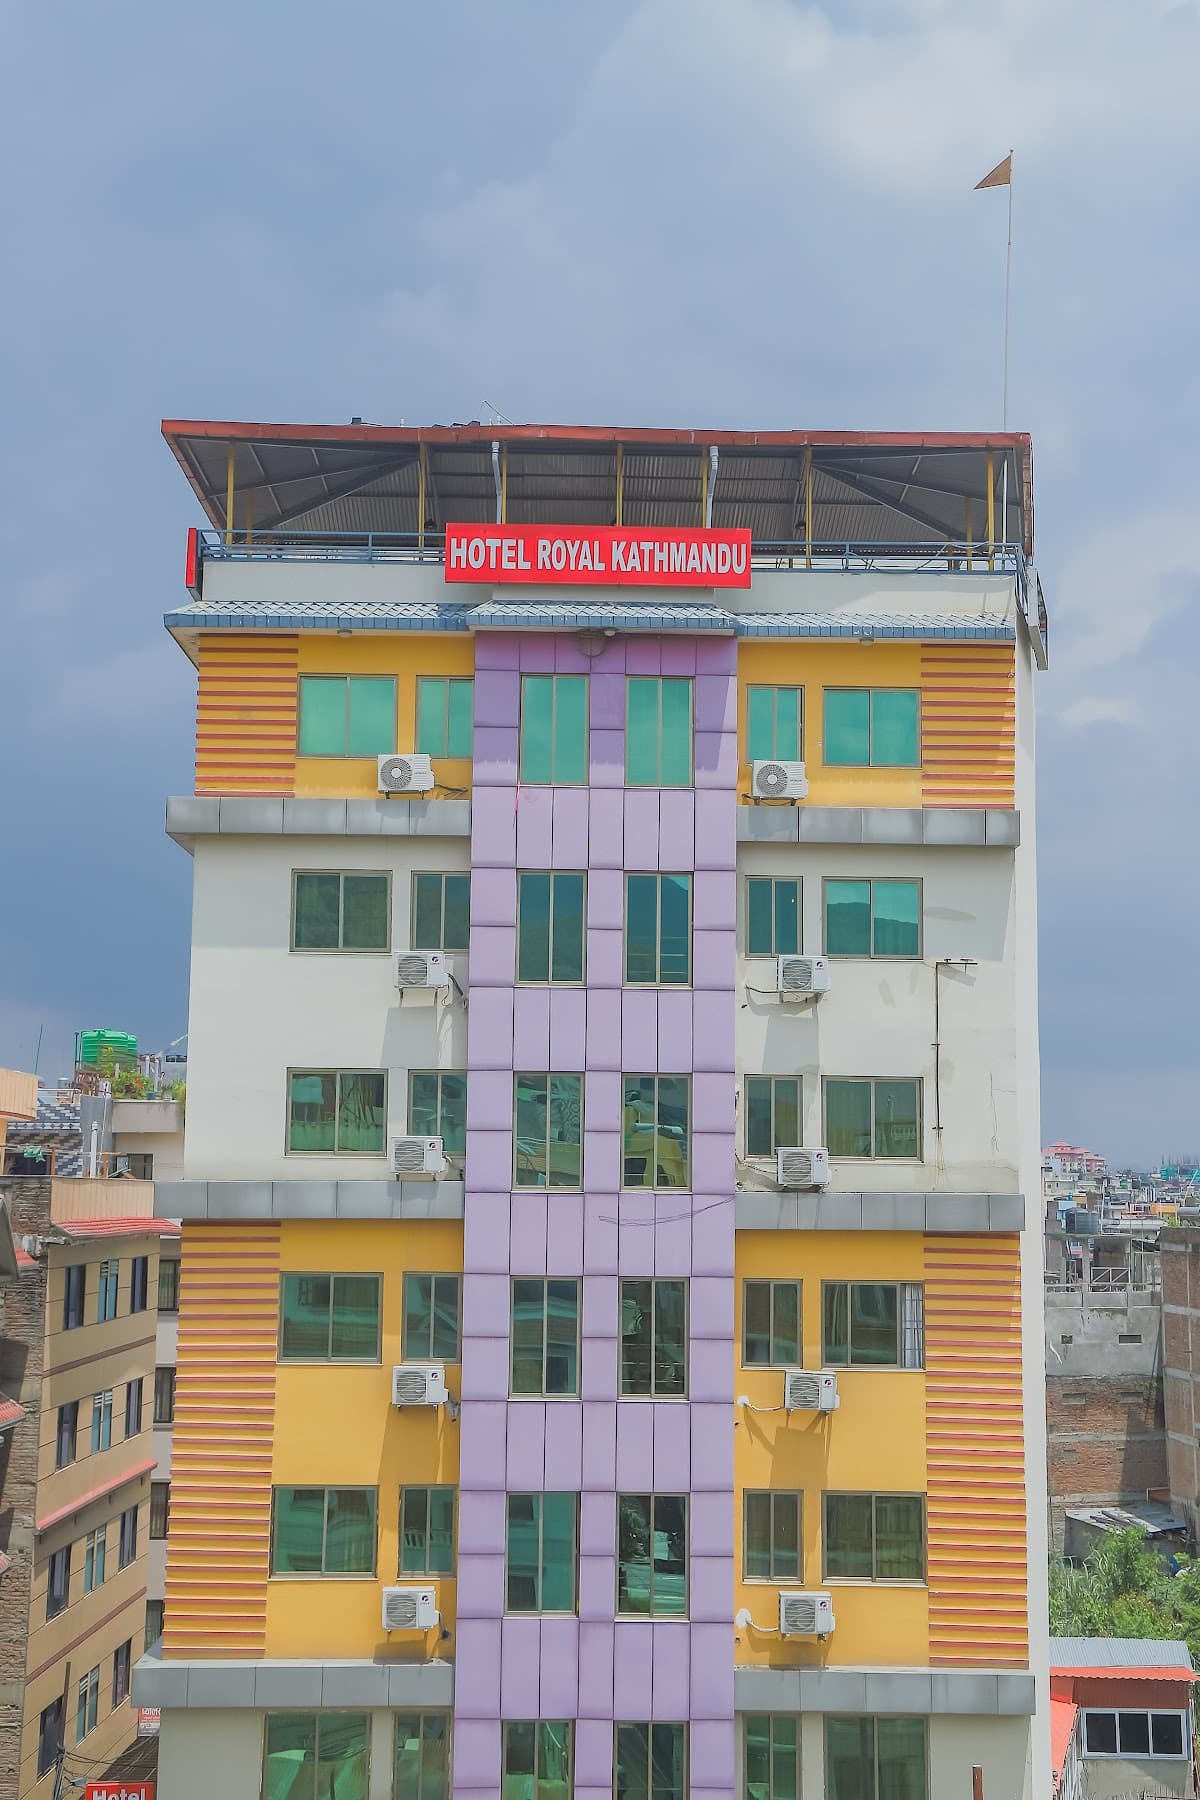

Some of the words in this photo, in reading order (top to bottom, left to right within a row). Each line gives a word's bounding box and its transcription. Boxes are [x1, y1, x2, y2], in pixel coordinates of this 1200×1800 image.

[450, 537, 531, 570] HOTEL
[537, 539, 605, 572] ROYAL
[611, 540, 747, 575] KATHMANDU
